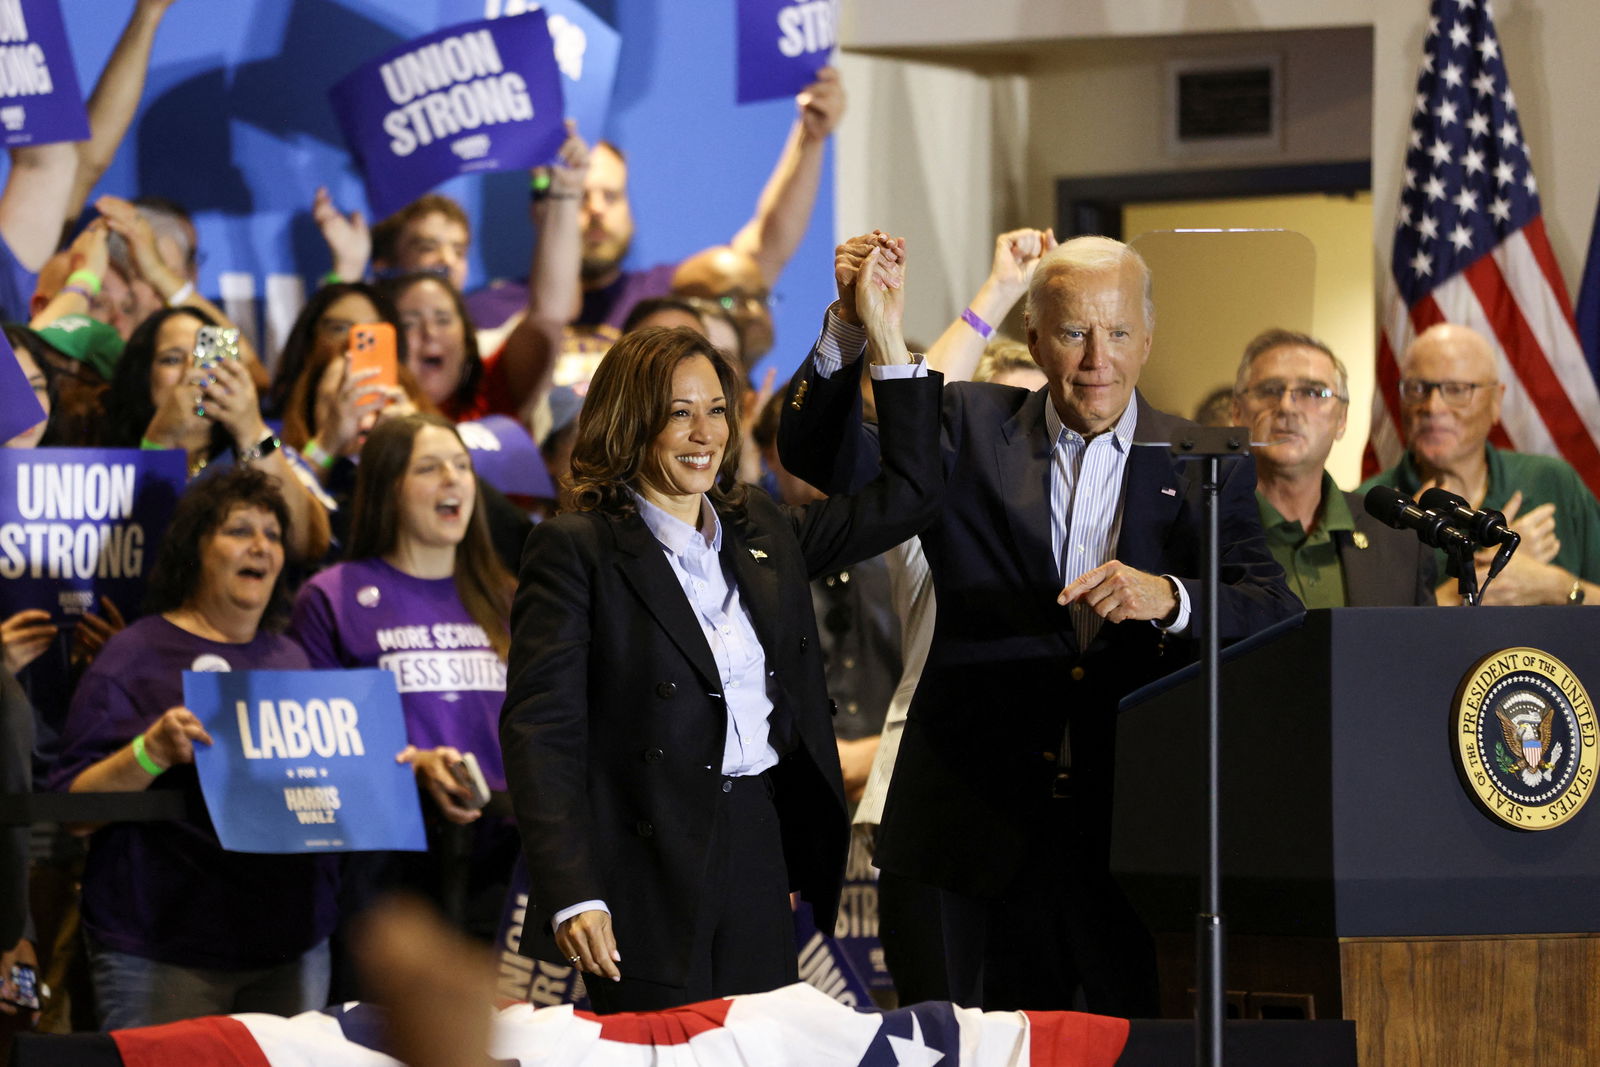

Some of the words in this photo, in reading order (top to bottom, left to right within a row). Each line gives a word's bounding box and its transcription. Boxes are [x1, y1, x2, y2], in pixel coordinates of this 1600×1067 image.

[379, 29, 503, 105] UNION
[383, 72, 534, 156] STRONG
[17, 463, 136, 520] UNION
[0, 522, 144, 579] STRONG
[376, 625, 434, 651] MORE
[448, 658, 507, 685] SUITS
[1523, 655, 1536, 667] OF
[1539, 659, 1557, 676] THE
[1463, 654, 1518, 735] PRESIDENT
[1561, 674, 1595, 748] UNITED
[236, 698, 365, 759] LABOR
[1466, 742, 1478, 768] THE
[296, 767, 317, 779] FOR
[1474, 770, 1486, 787] OF
[284, 787, 341, 811] HARRIS
[1488, 784, 1523, 822] SEAL
[1548, 764, 1593, 821] STATES
[297, 810, 336, 824] WALZ
